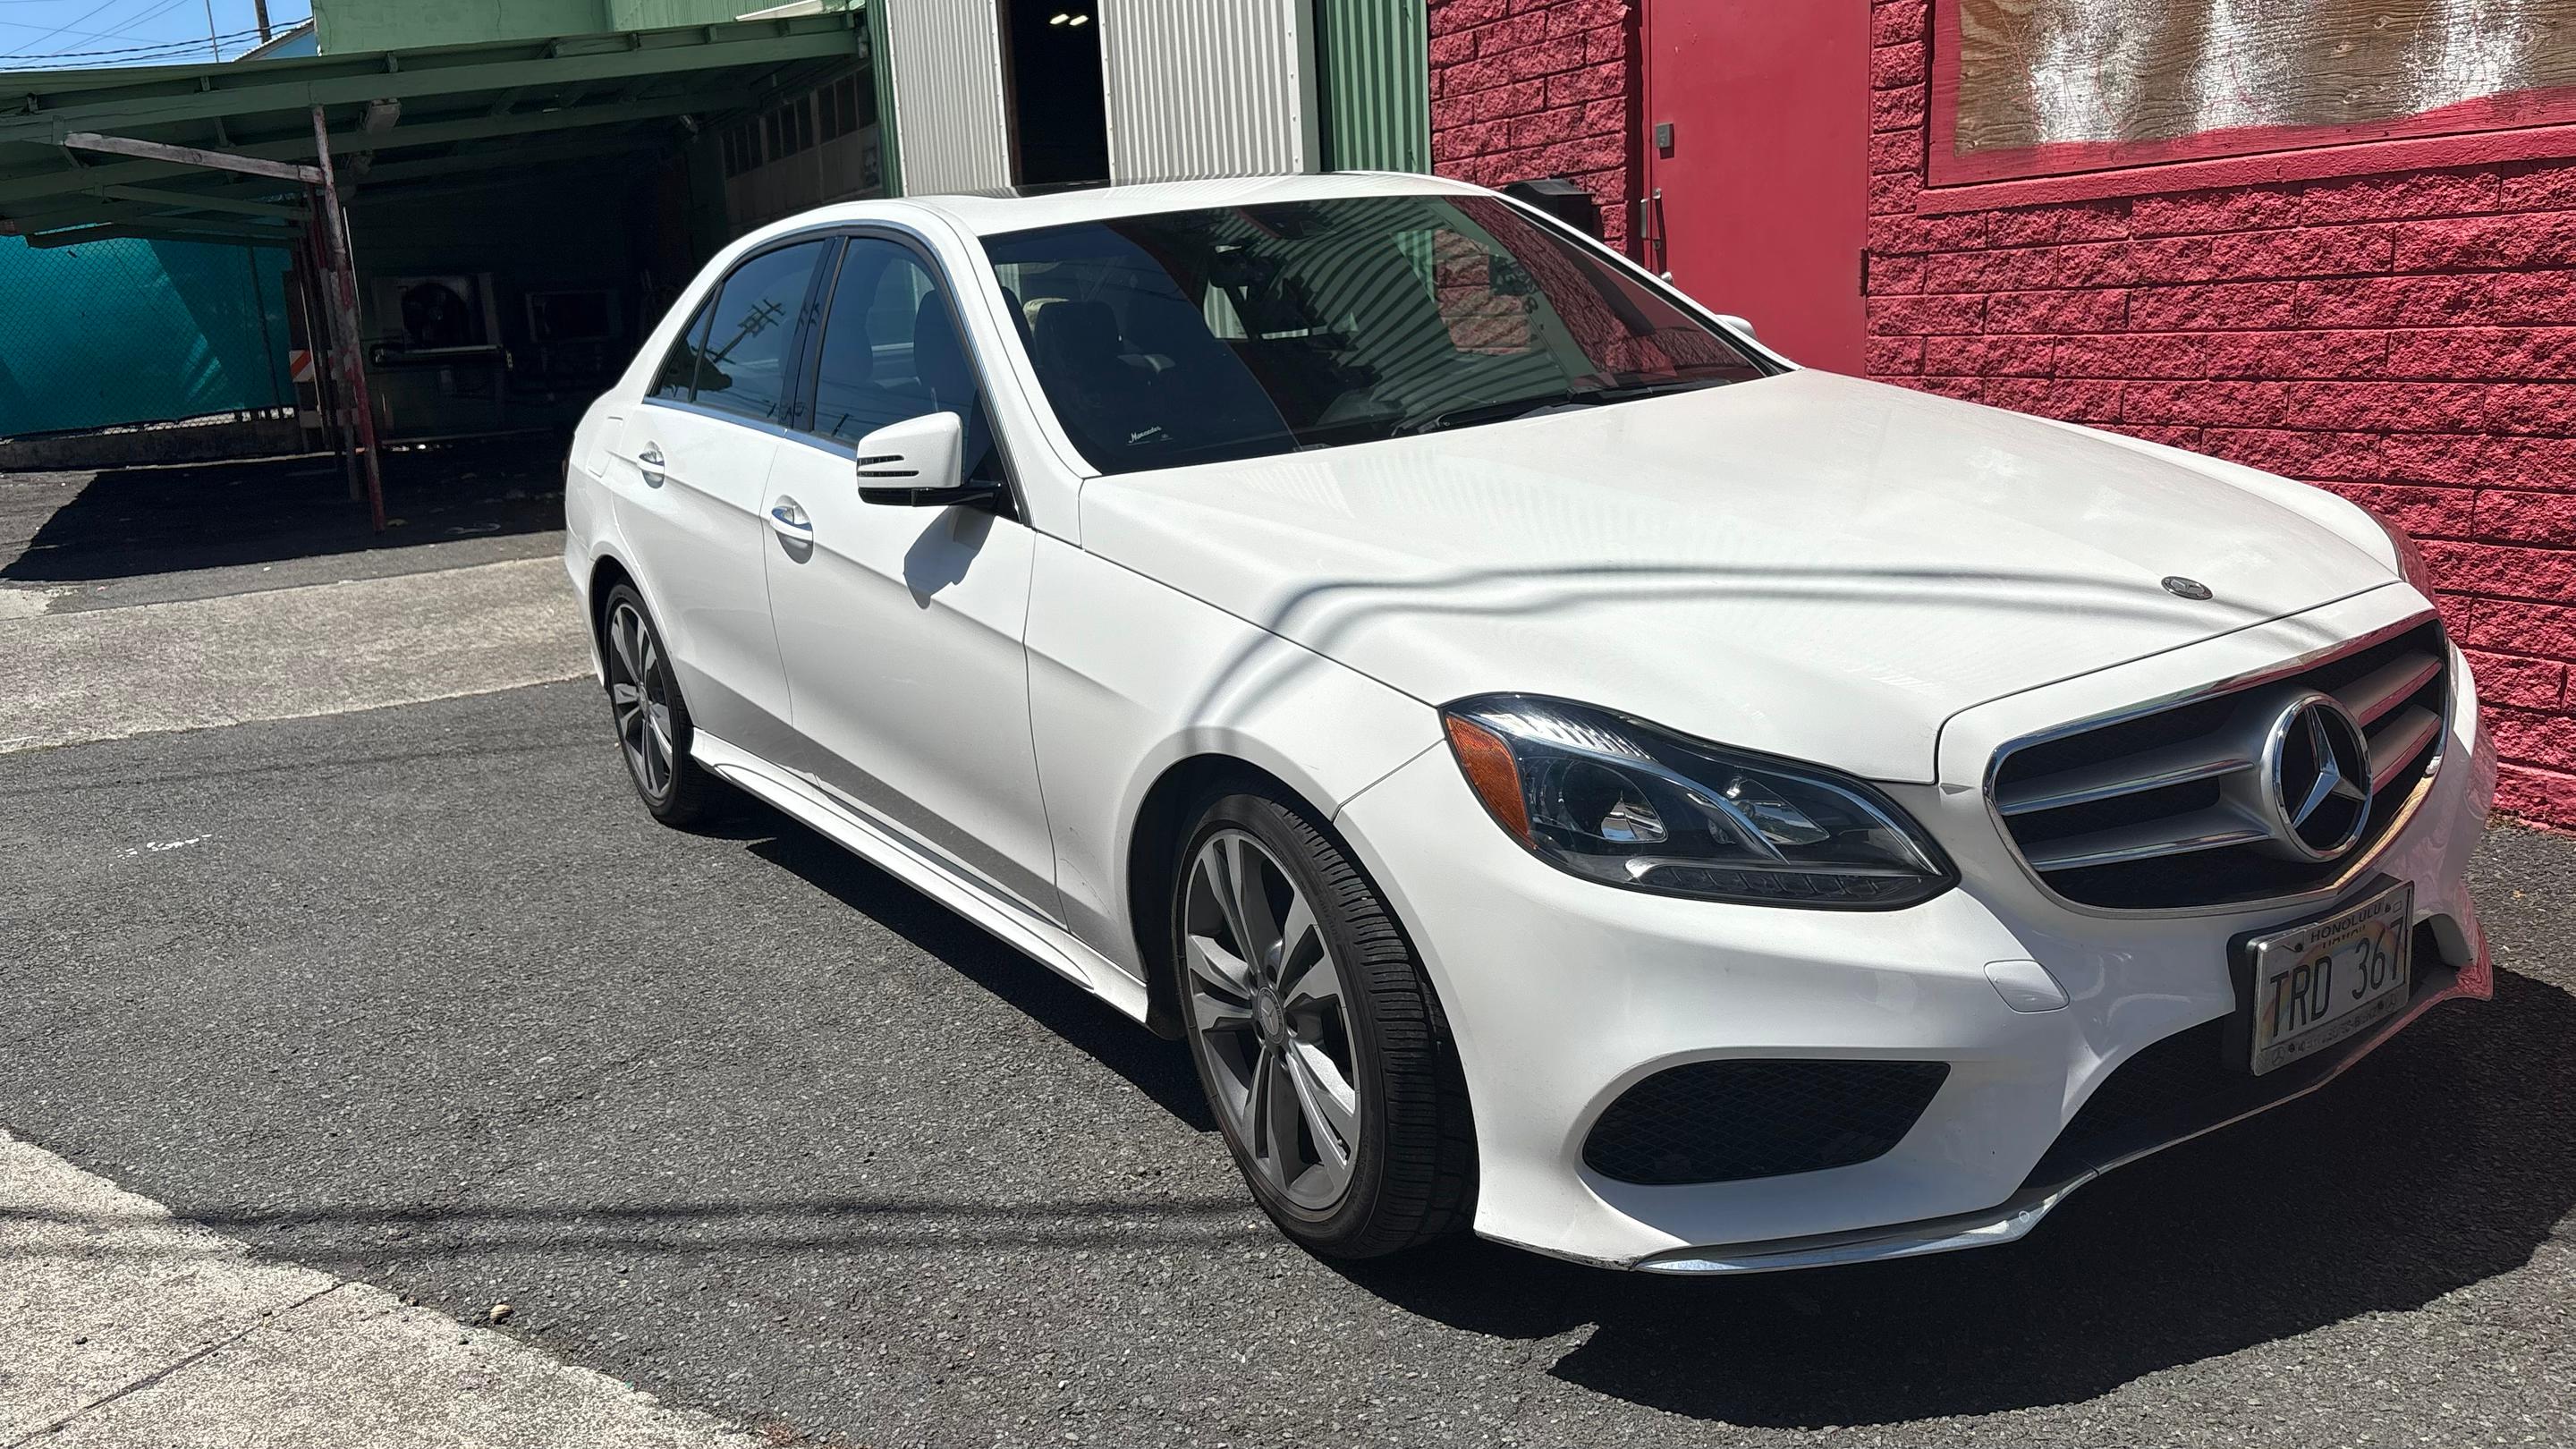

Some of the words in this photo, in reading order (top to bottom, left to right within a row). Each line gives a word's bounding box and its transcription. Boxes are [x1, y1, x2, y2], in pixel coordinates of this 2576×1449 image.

[2310, 903, 2382, 943] HONOLULU
[2270, 955, 2333, 1038] TRD
[2351, 916, 2404, 1000] 367
